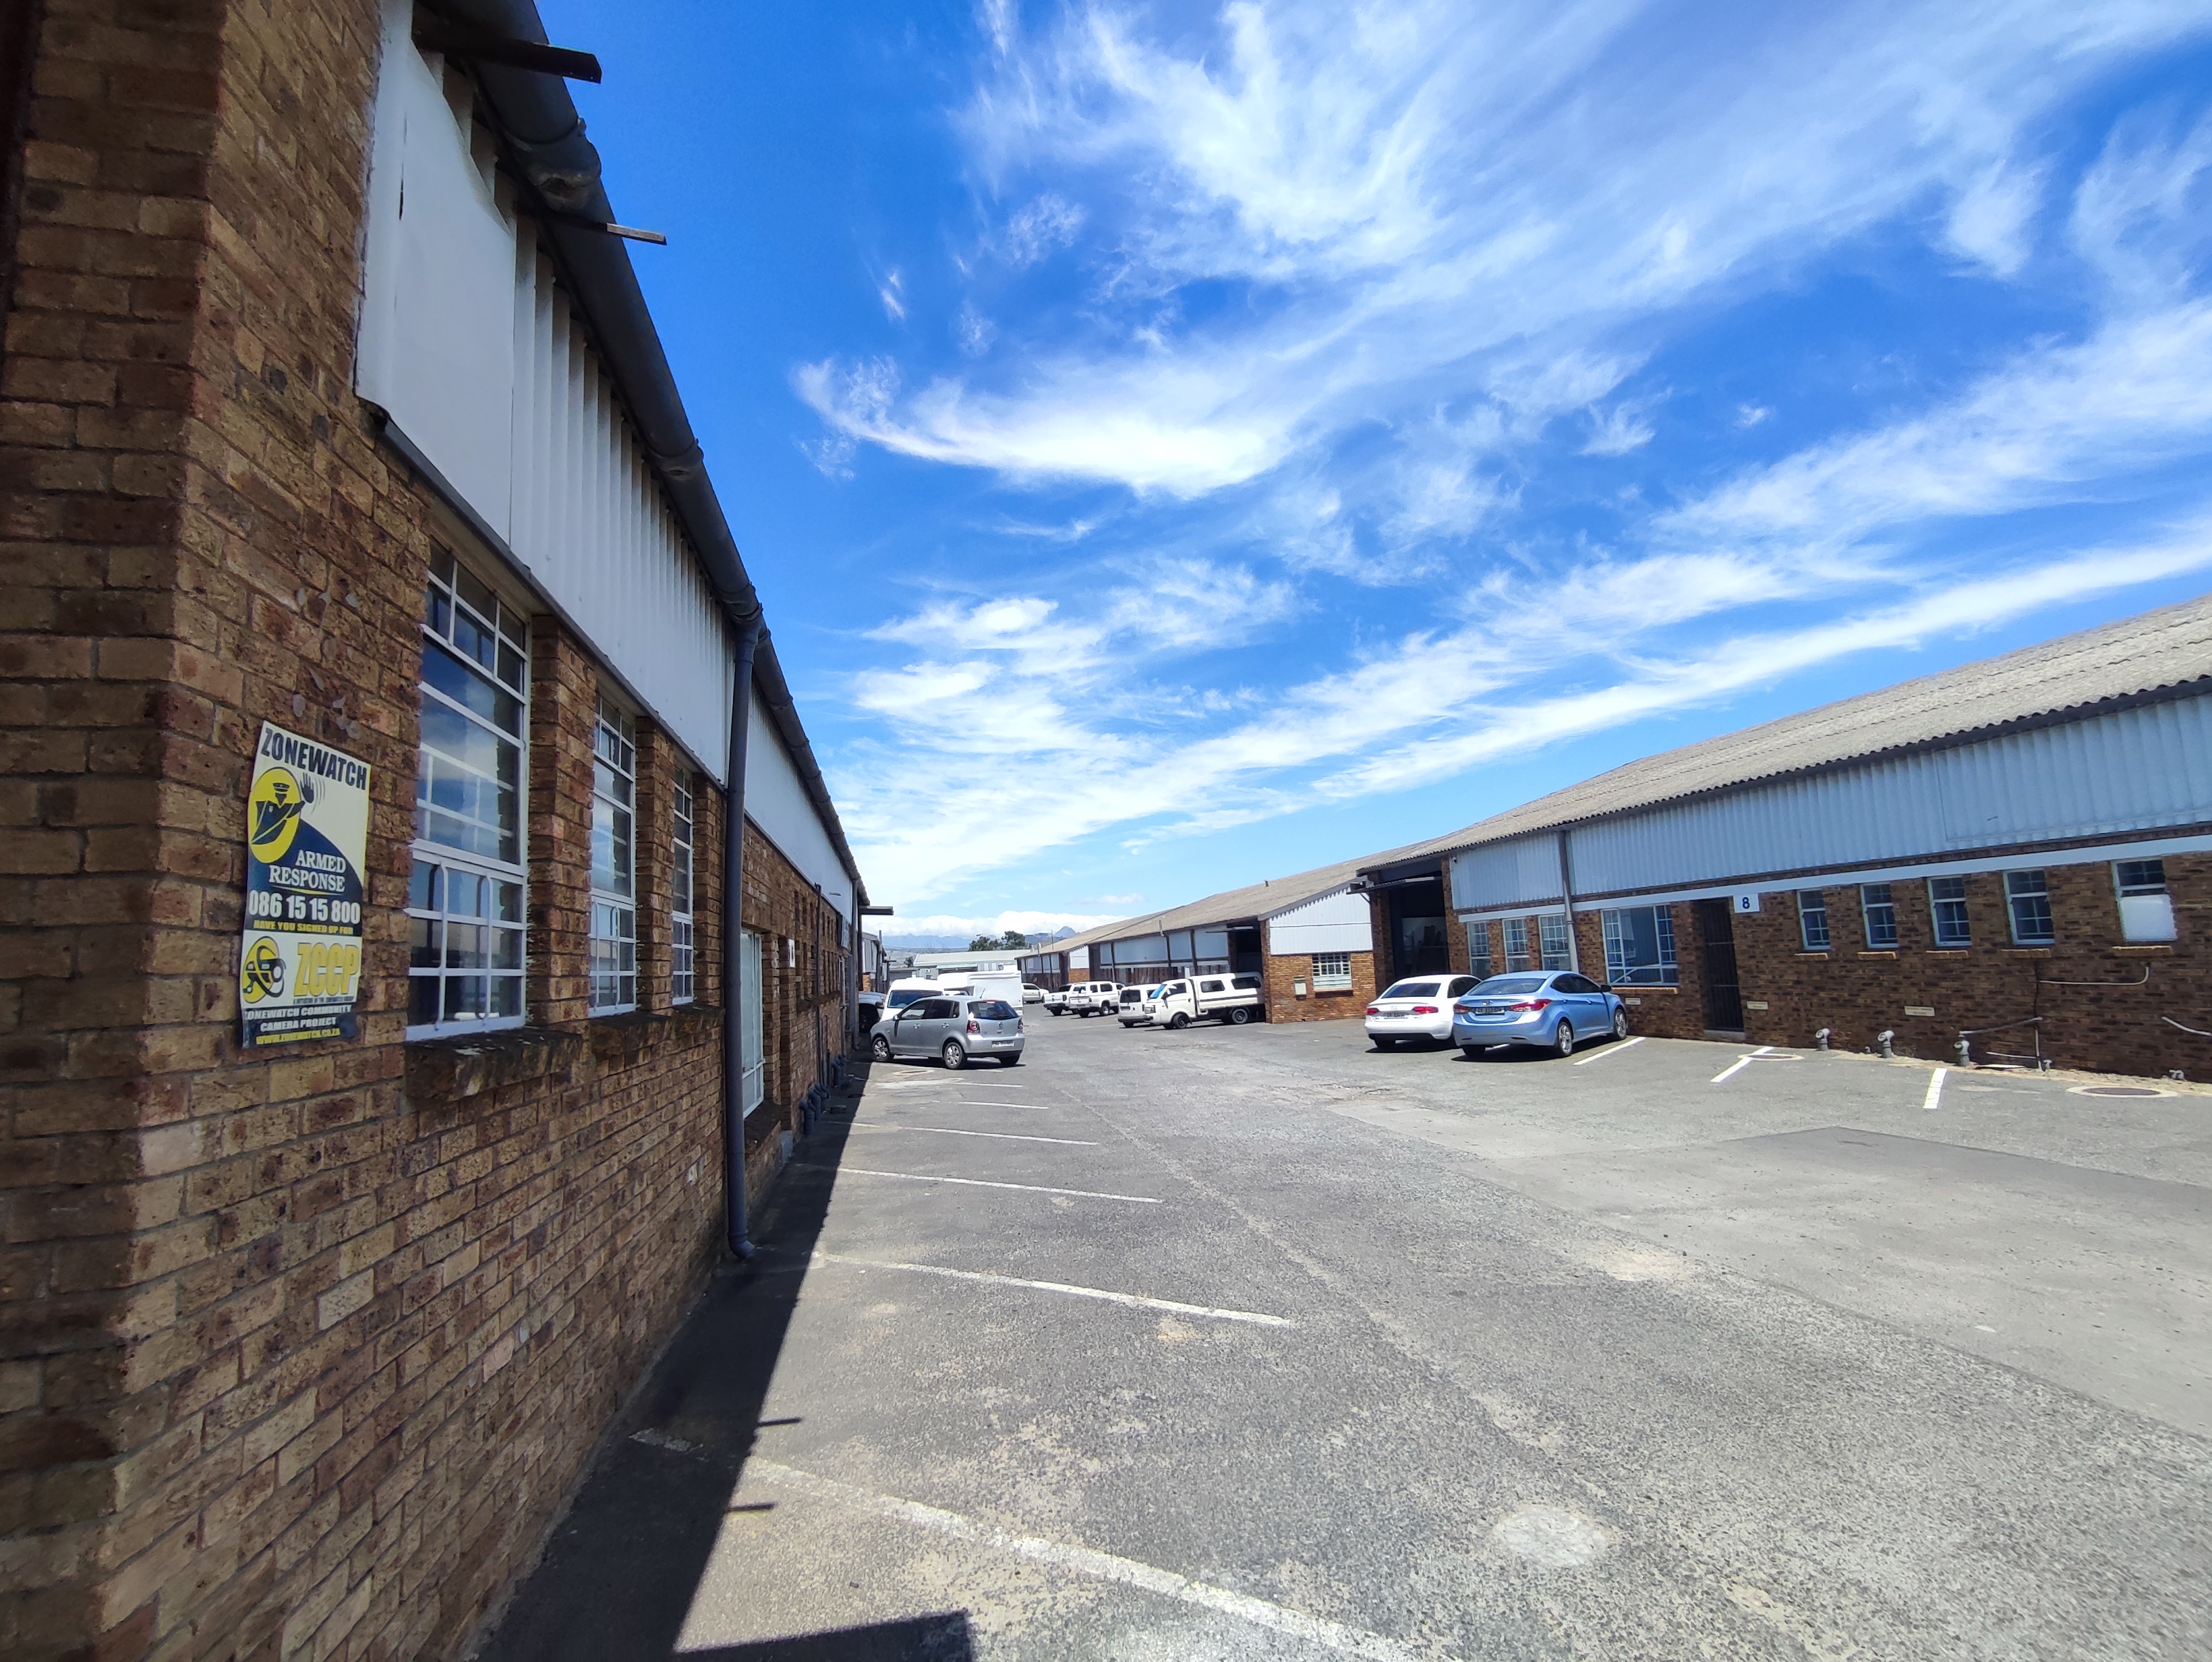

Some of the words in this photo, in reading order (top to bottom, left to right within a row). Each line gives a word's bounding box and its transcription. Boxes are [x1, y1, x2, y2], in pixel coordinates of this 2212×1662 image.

[260, 727, 368, 791] ZONEWATCH
[295, 849, 347, 873] ARMED
[268, 865, 345, 892] RESPONSE
[249, 890, 283, 917] 086
[286, 895, 306, 919] 15
[309, 898, 328, 921] 15
[331, 900, 361, 924] 800
[1742, 896, 1750, 909] 8
[254, 919, 276, 929] HAVE
[277, 921, 295, 931] YOU
[297, 923, 327, 933] SIGNED
[328, 925, 339, 934] UP
[339, 926, 353, 935] FOR
[293, 942, 359, 996] ZCCP
[301, 1004, 352, 1016] COMMUNITY
[260, 1020, 299, 1032] CAMERA
[300, 1016, 337, 1028] PROJECT
